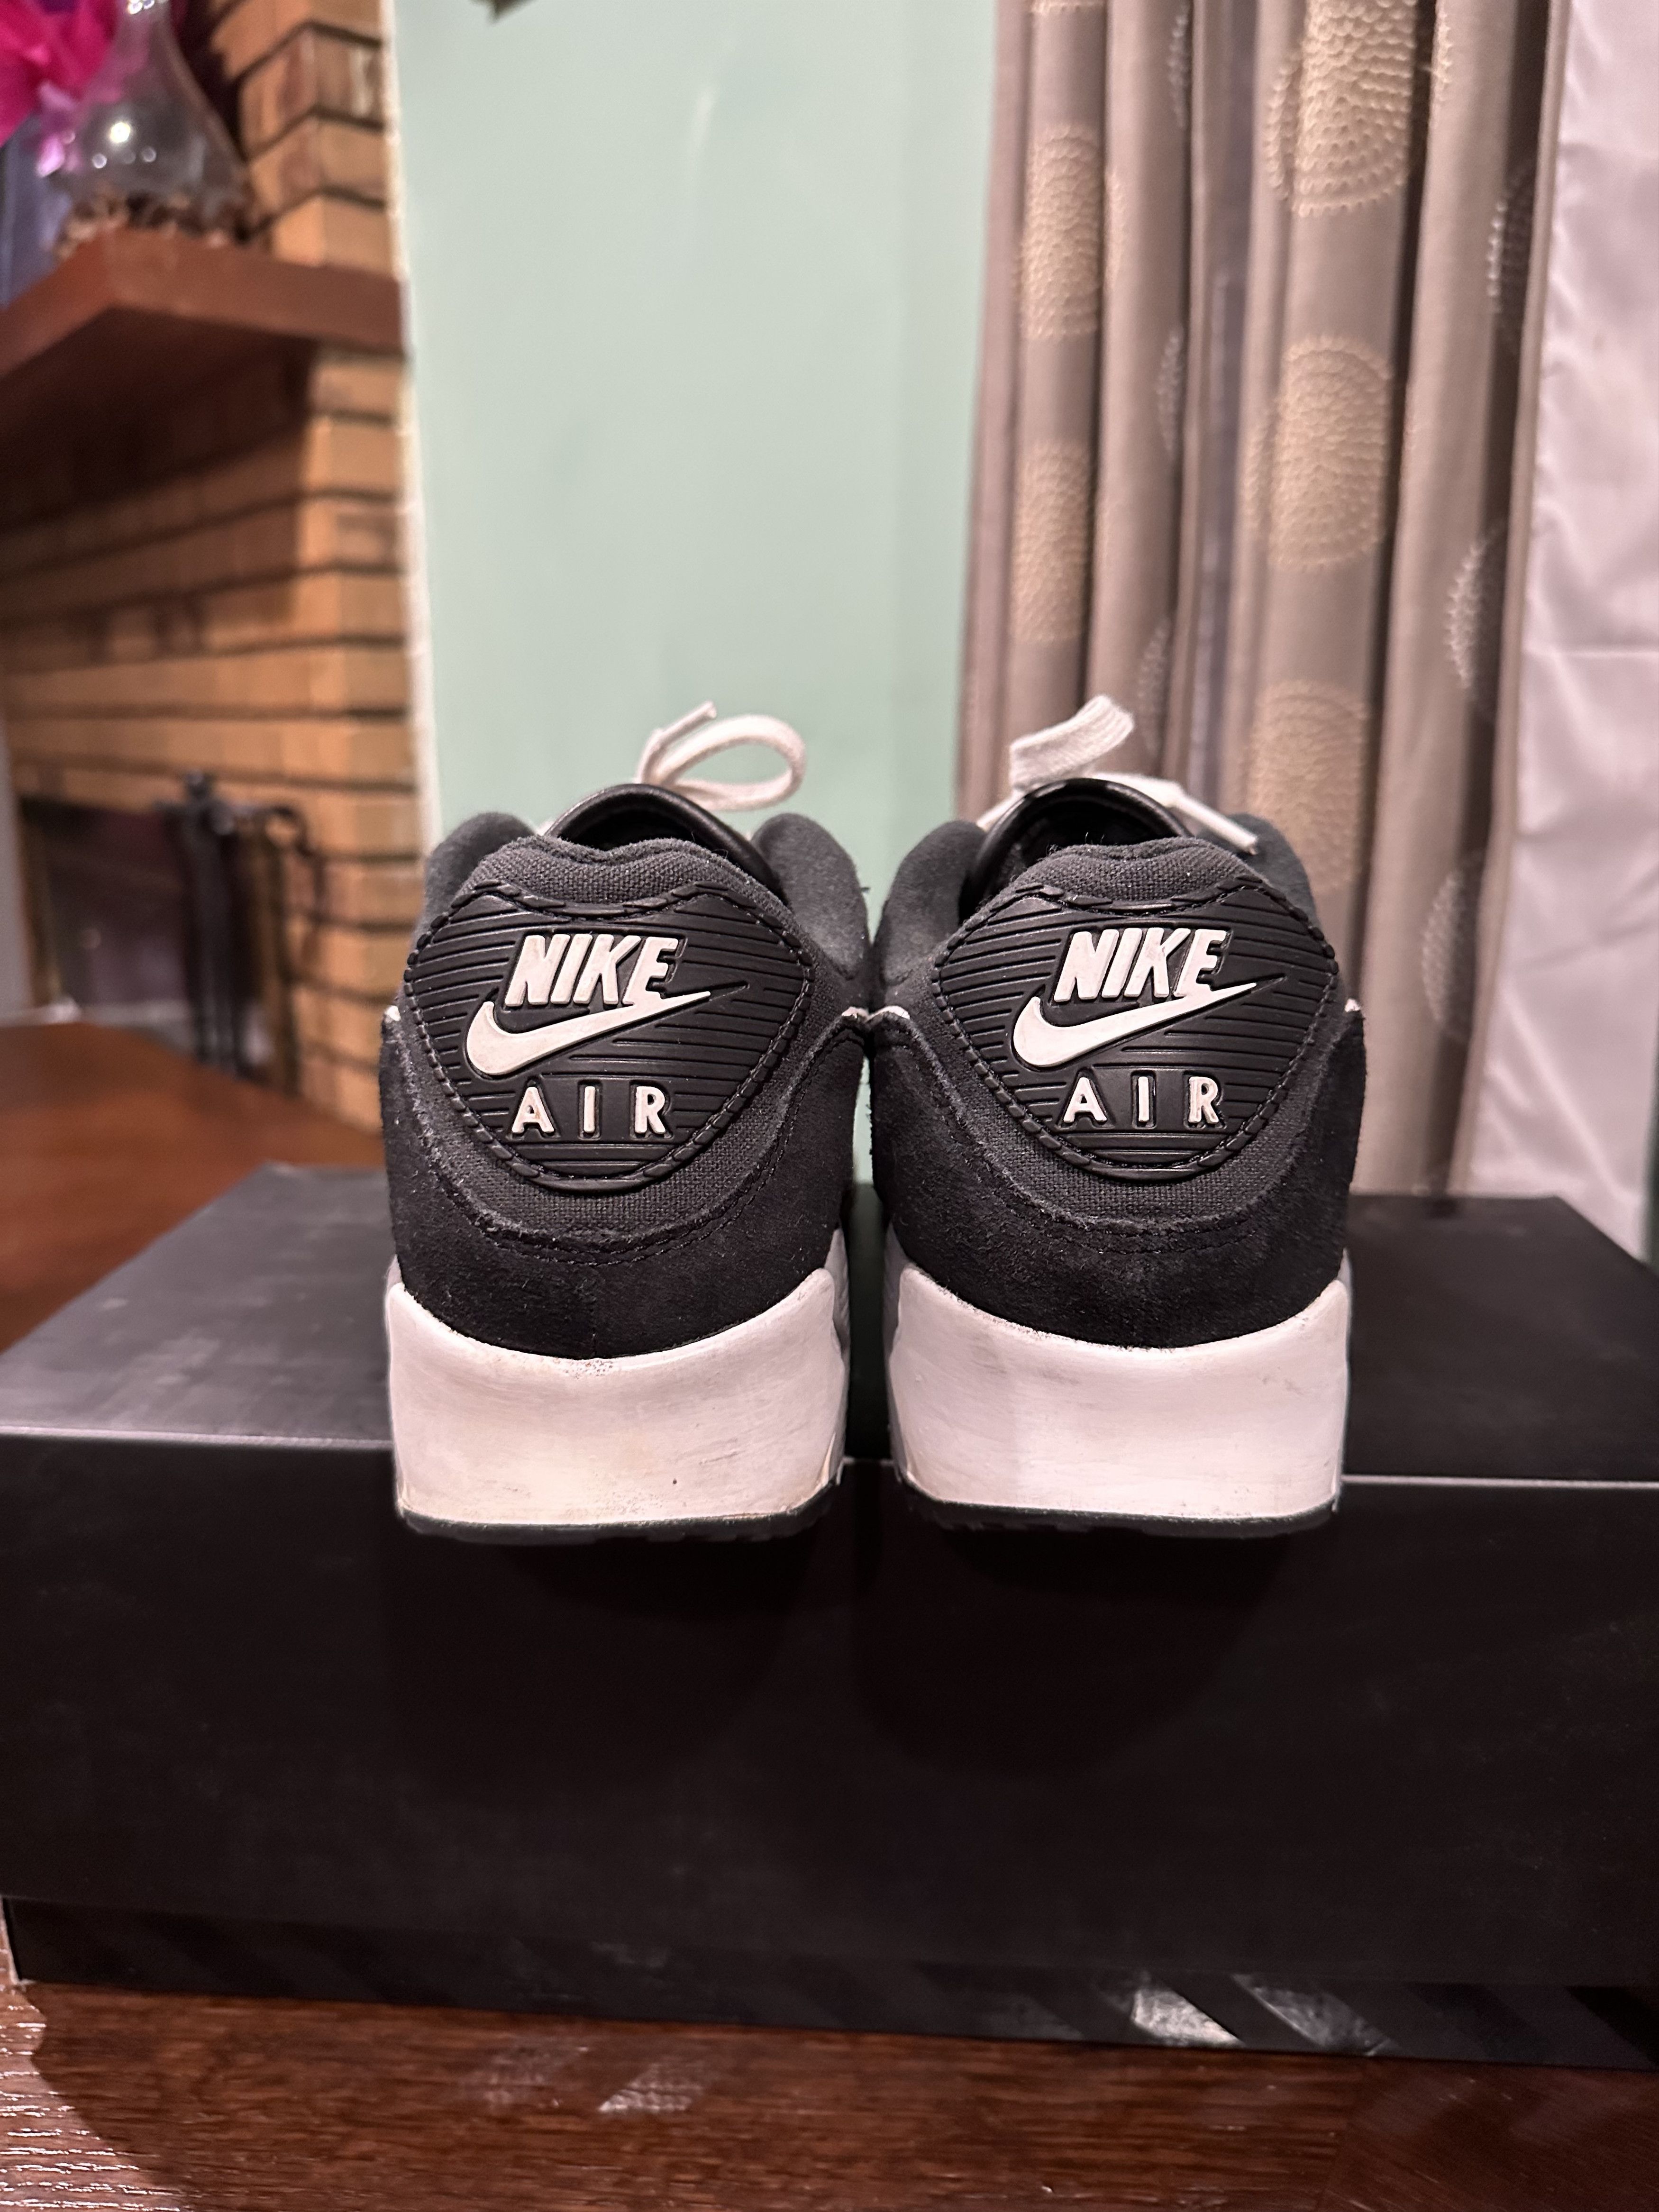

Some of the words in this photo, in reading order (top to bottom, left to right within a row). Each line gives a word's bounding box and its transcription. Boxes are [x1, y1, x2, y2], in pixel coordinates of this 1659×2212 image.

[505, 934, 678, 1007] NIKE
[1053, 927, 1227, 1003] NIKE
[511, 1085, 666, 1134] AIR
[1063, 1076, 1219, 1123] AIR
